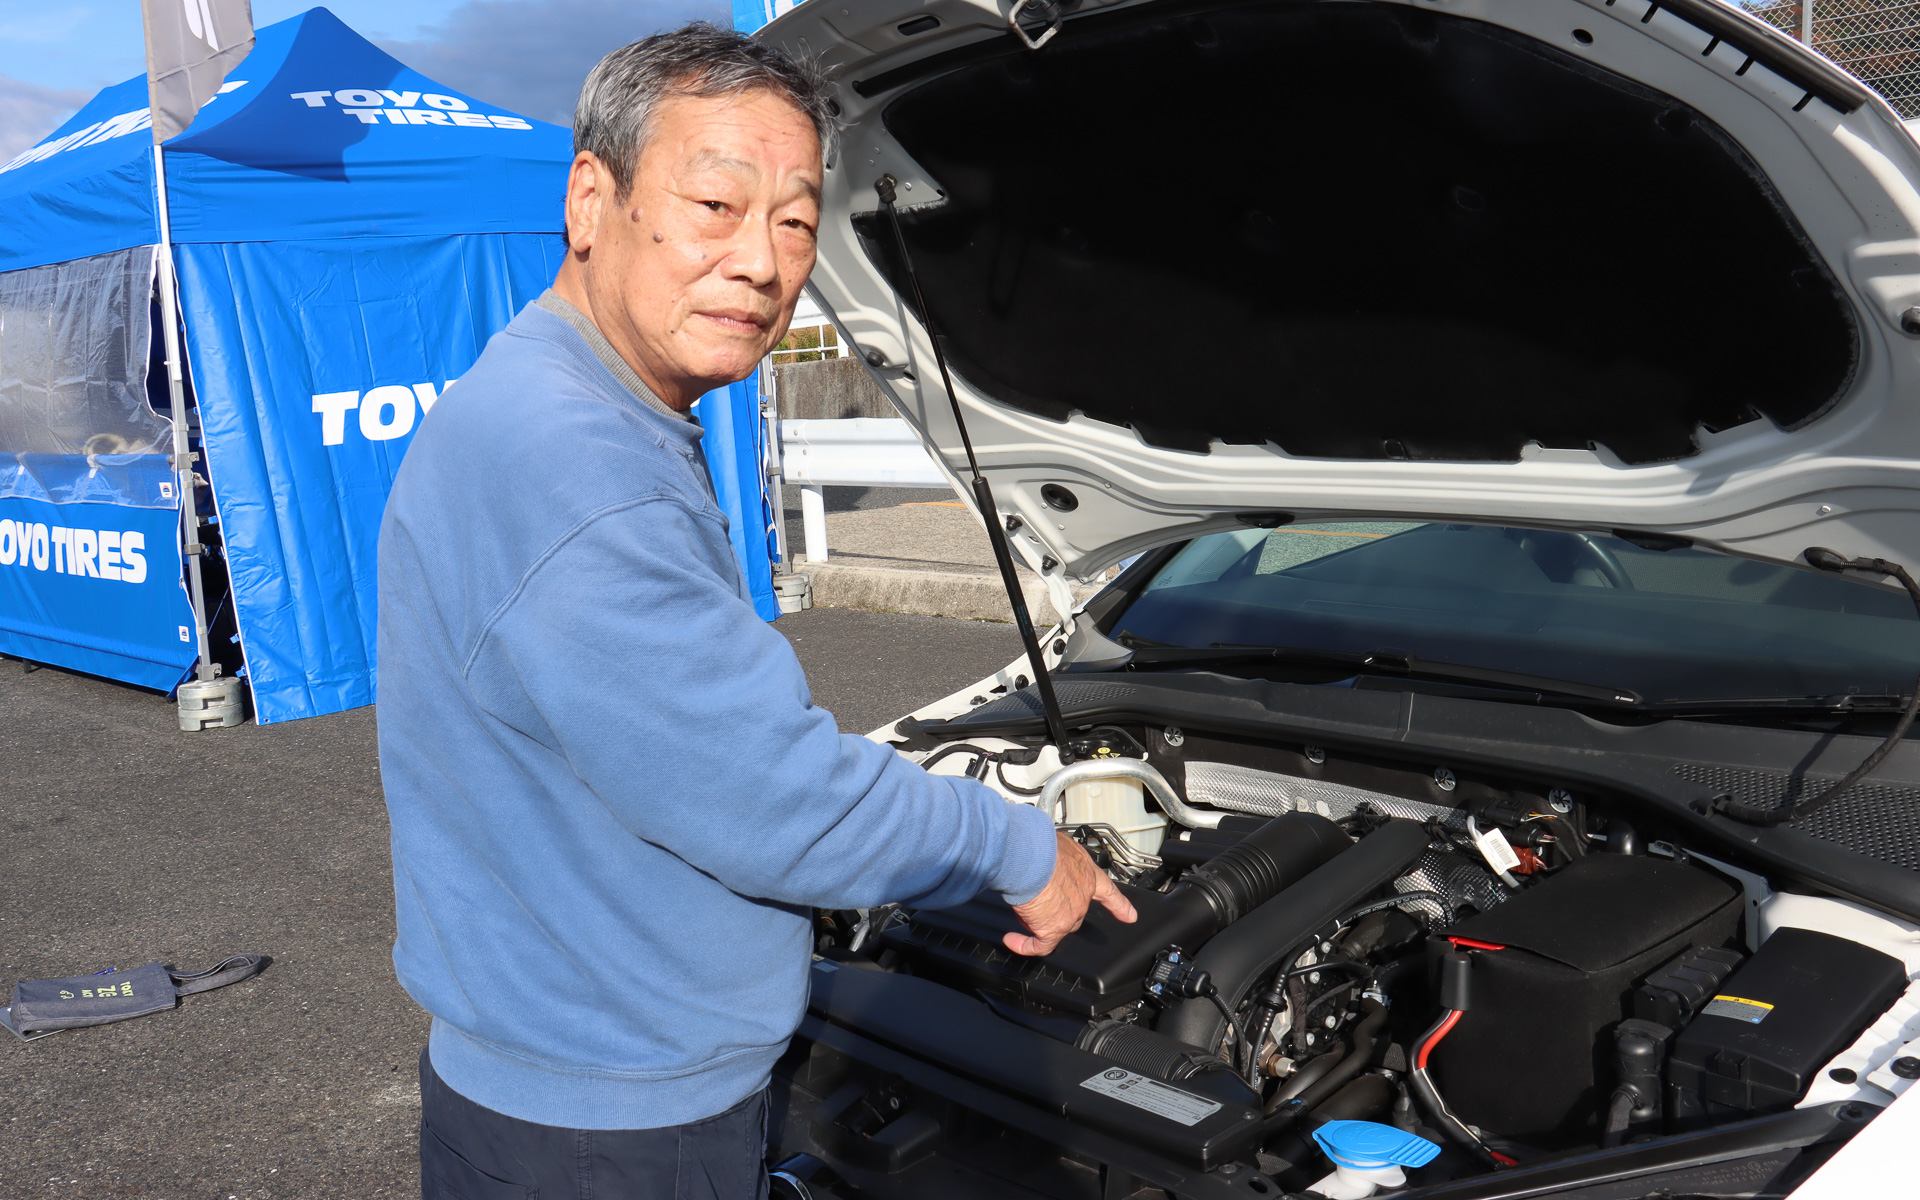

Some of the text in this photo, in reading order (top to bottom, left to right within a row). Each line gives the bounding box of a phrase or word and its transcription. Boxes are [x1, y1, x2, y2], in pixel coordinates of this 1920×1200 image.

[290, 88, 470, 111] TOYO
[342, 108, 533, 130] TIRES
[51, 525, 148, 584] TIRES
